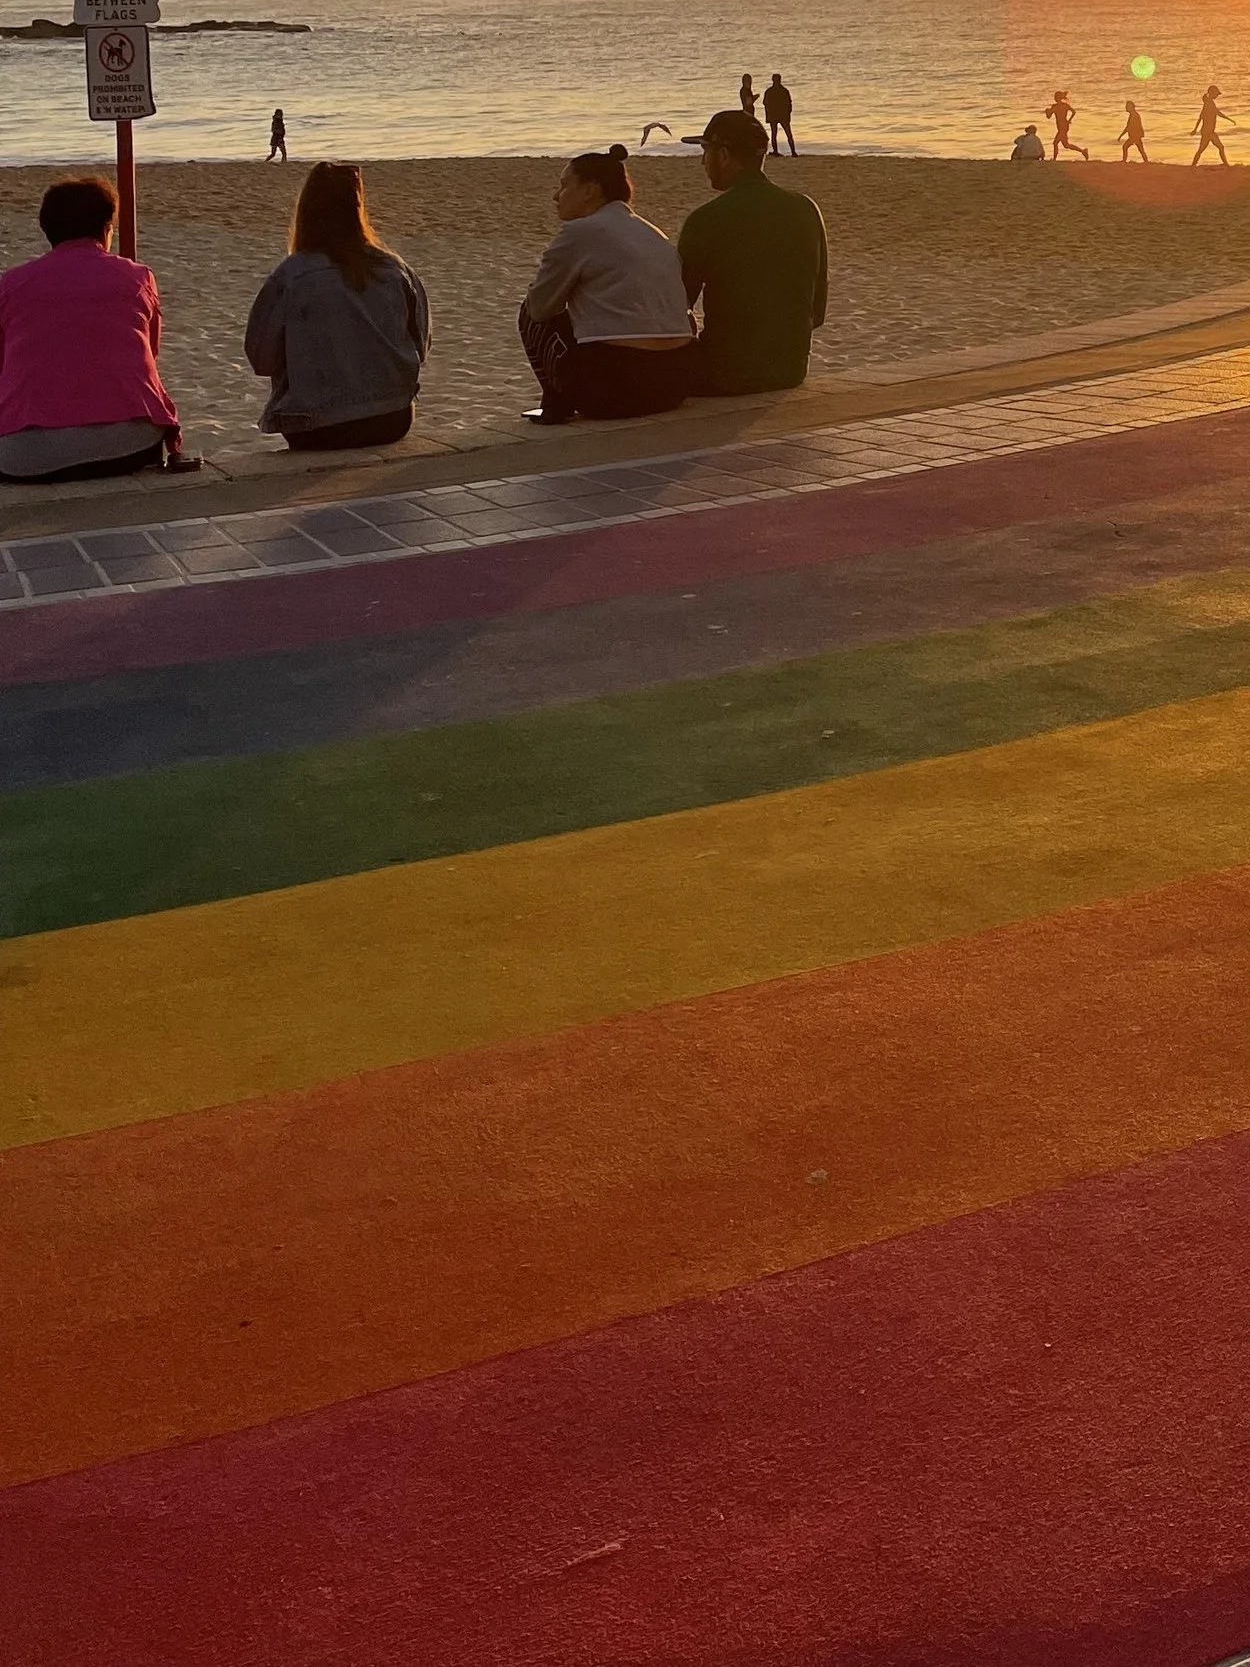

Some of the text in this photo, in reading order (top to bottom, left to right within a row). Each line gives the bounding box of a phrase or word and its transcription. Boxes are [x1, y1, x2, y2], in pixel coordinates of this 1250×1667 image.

[95, 9, 137, 20] FLAGS
[104, 74, 130, 82] DOGS
[93, 84, 145, 92] PROHIBITED
[96, 94, 142, 103] ON BEACH
